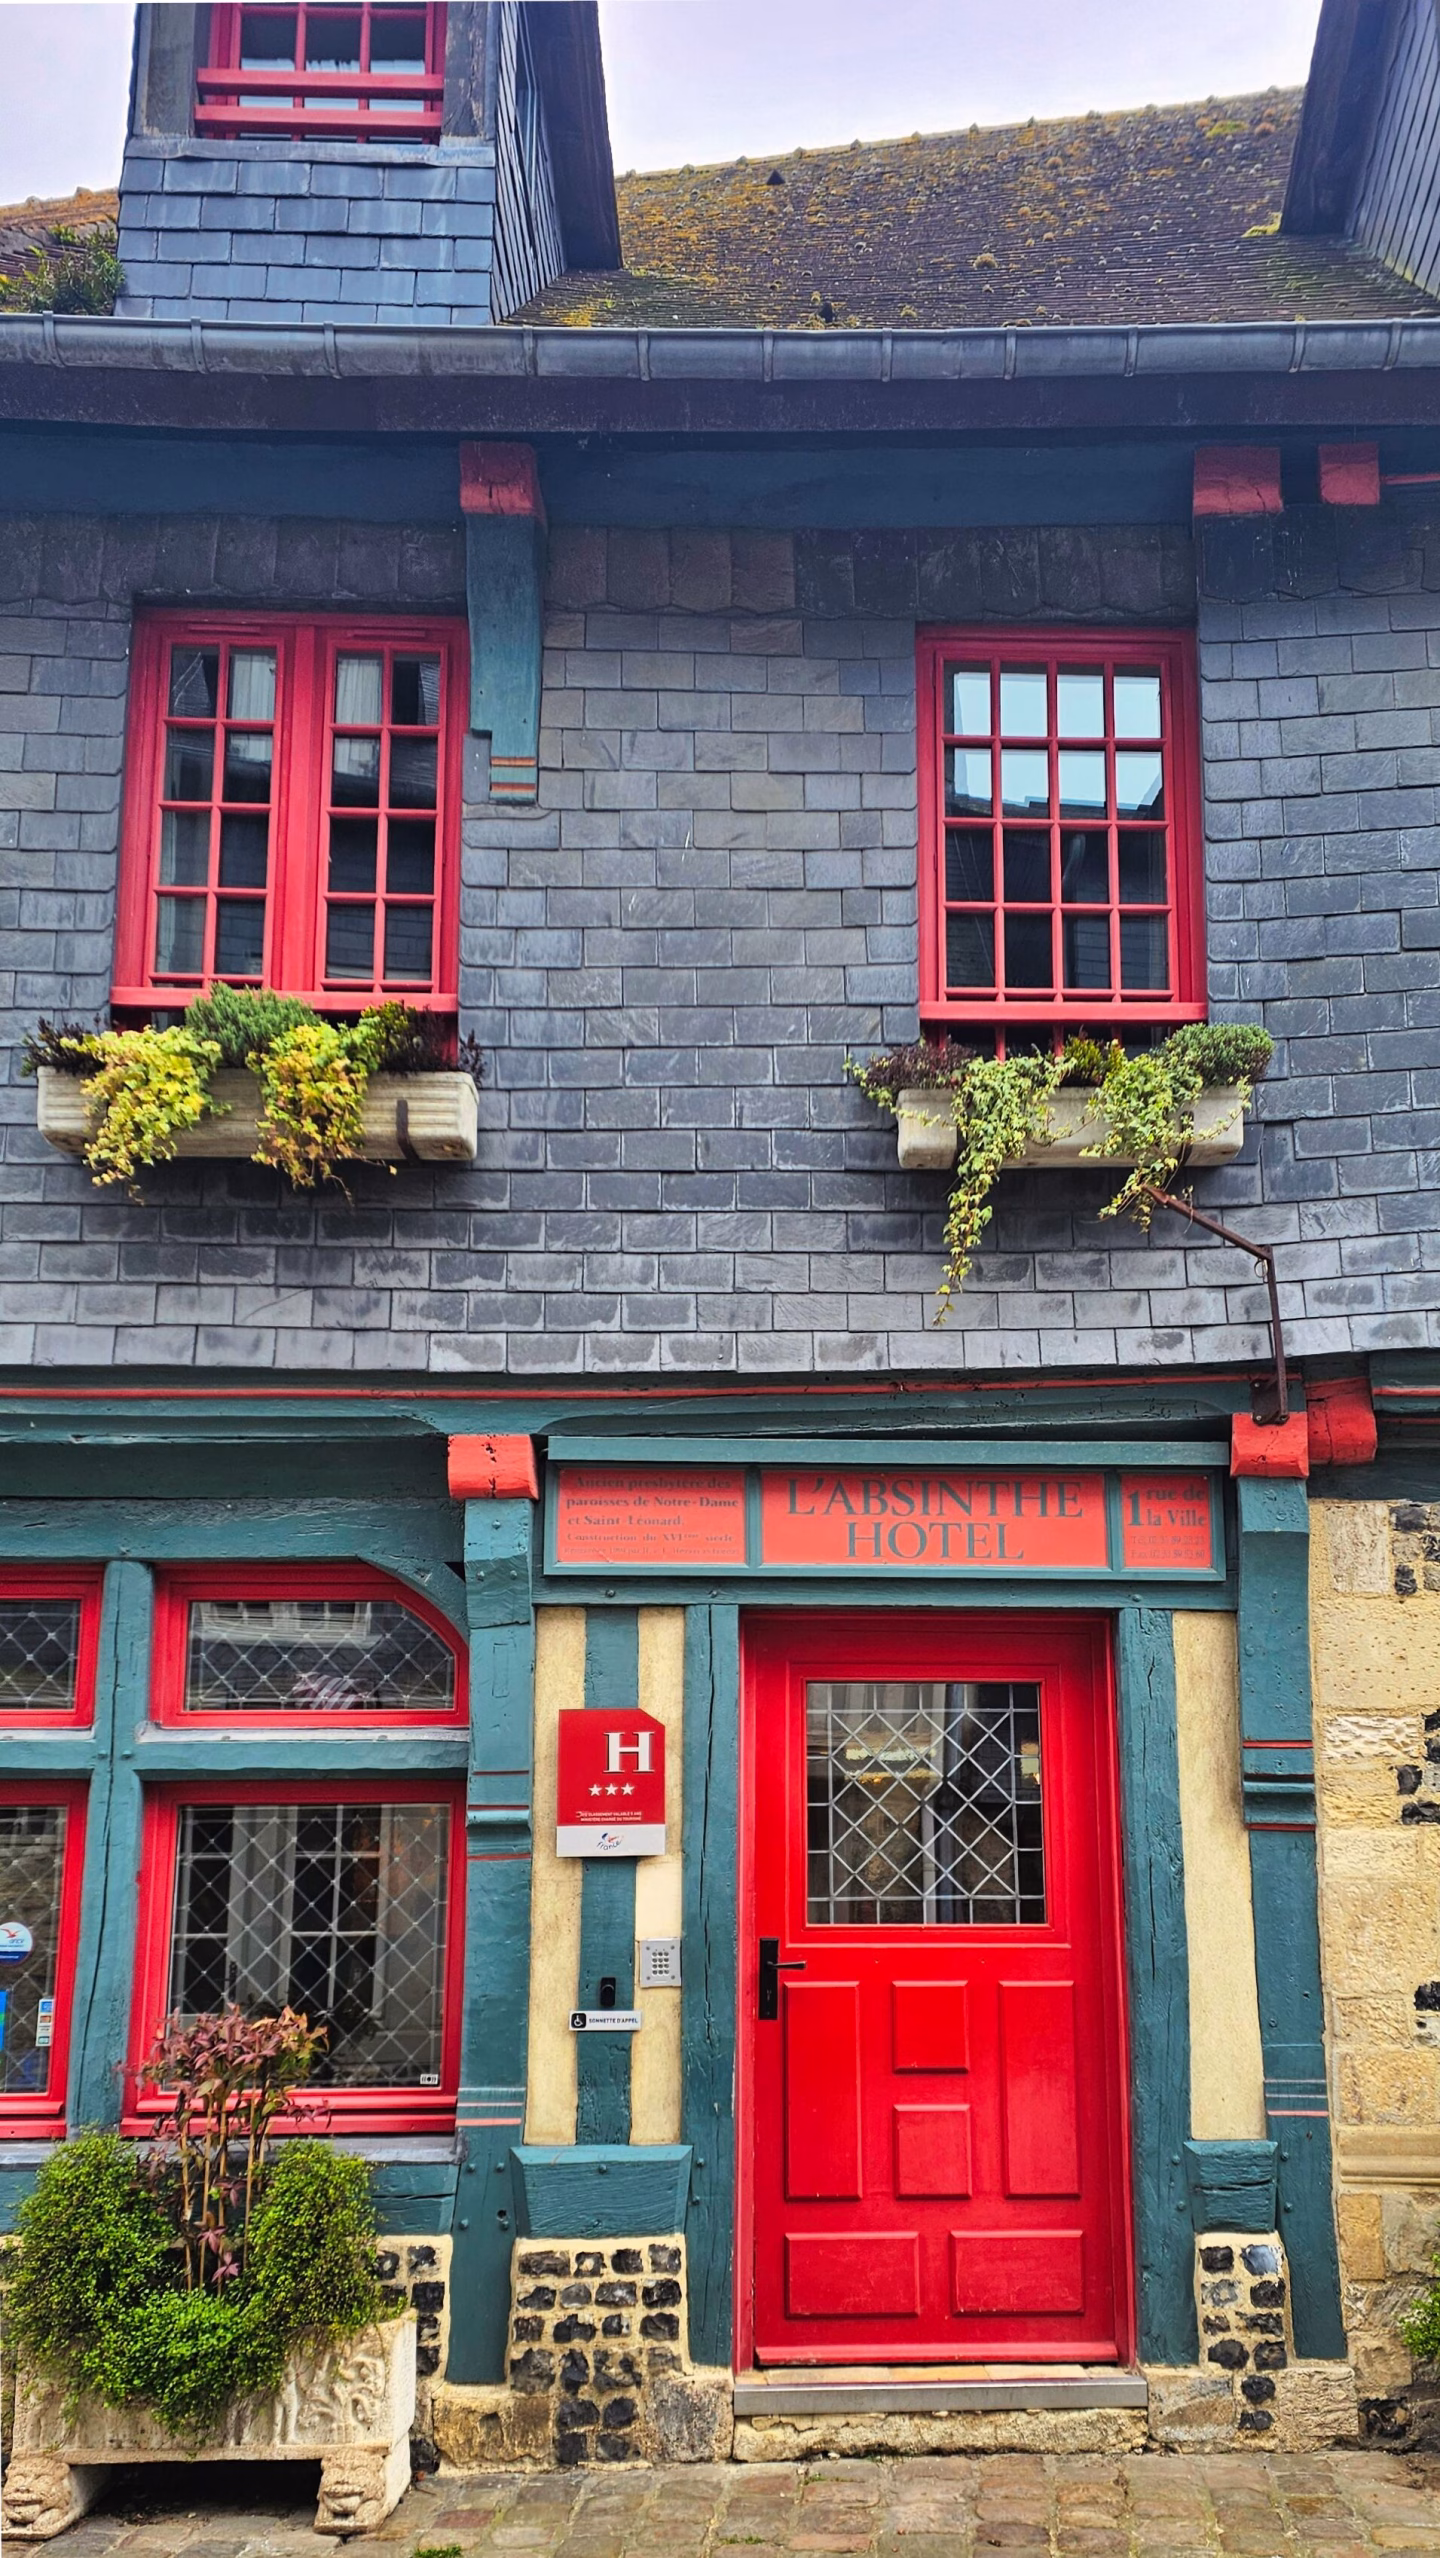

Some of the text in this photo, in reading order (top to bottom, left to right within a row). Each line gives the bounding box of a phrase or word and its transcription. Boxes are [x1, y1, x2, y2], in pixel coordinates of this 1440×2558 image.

[708, 1477, 731, 1488] des
[567, 1498, 629, 1510] paroisses
[633, 1496, 650, 1507] de
[788, 1477, 1083, 1518] L'ABSINTHE
[1127, 1485, 1205, 1526] 1 rue de
[567, 1517, 581, 1525] et
[584, 1515, 620, 1526] Saint
[1147, 1509, 1204, 1526] la Ville
[845, 1521, 1024, 1560] HOTEL
[603, 1731, 655, 1774] H
